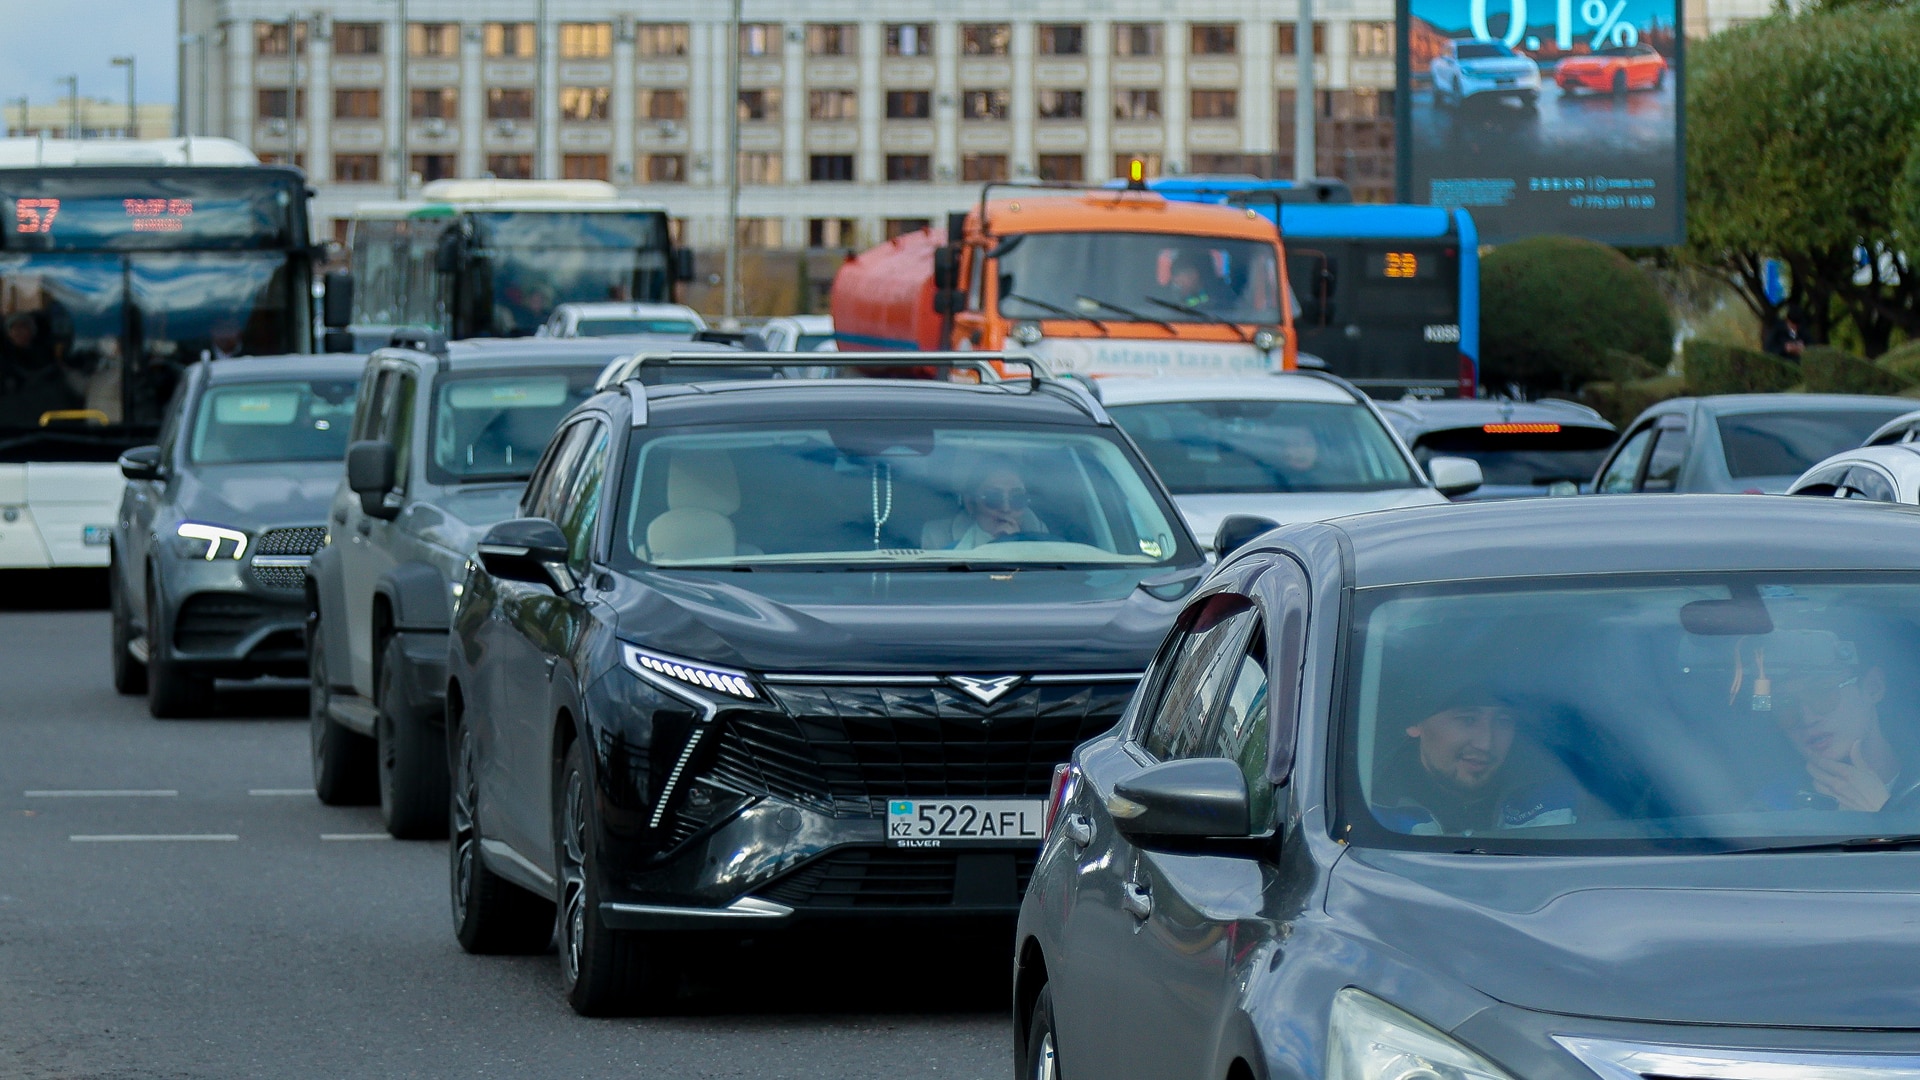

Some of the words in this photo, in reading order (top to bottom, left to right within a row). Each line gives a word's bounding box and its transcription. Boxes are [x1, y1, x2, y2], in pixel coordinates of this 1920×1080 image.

[1470, 0, 1639, 50] 0.1%
[16, 199, 60, 232] 57
[1097, 349, 1171, 366] Astana
[891, 823, 912, 836] KZ
[897, 840, 941, 848] SILVER
